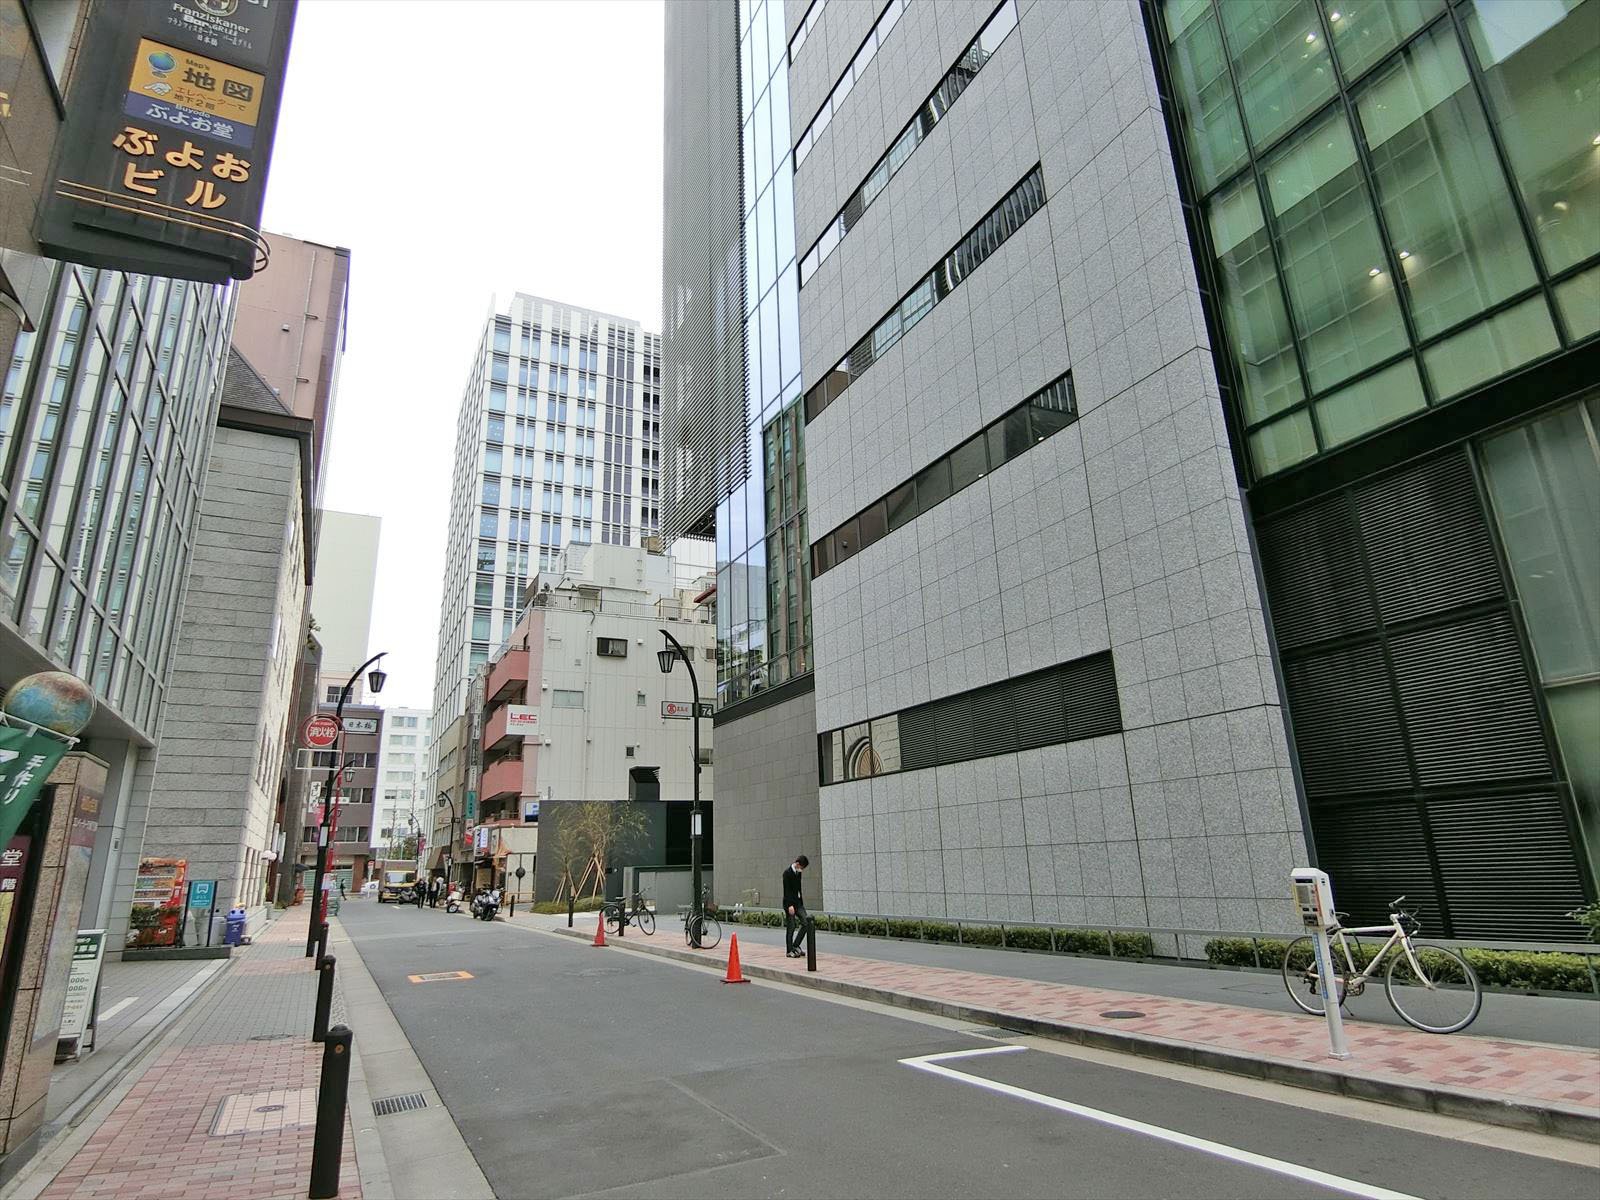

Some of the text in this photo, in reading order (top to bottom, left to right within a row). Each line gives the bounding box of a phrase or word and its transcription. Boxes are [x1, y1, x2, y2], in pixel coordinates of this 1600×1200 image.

[173, 2, 250, 34] Franziskaner
[146, 103, 234, 139] ぶよお堂
[175, 103, 211, 118] Buyodo
[112, 126, 251, 182] ぶよお
[124, 163, 227, 209] ビル
[309, 726, 335, 738] 消火栓
[510, 712, 537, 721] LEC
[4, 755, 47, 805] 手作り
[1, 849, 23, 867] 堂
